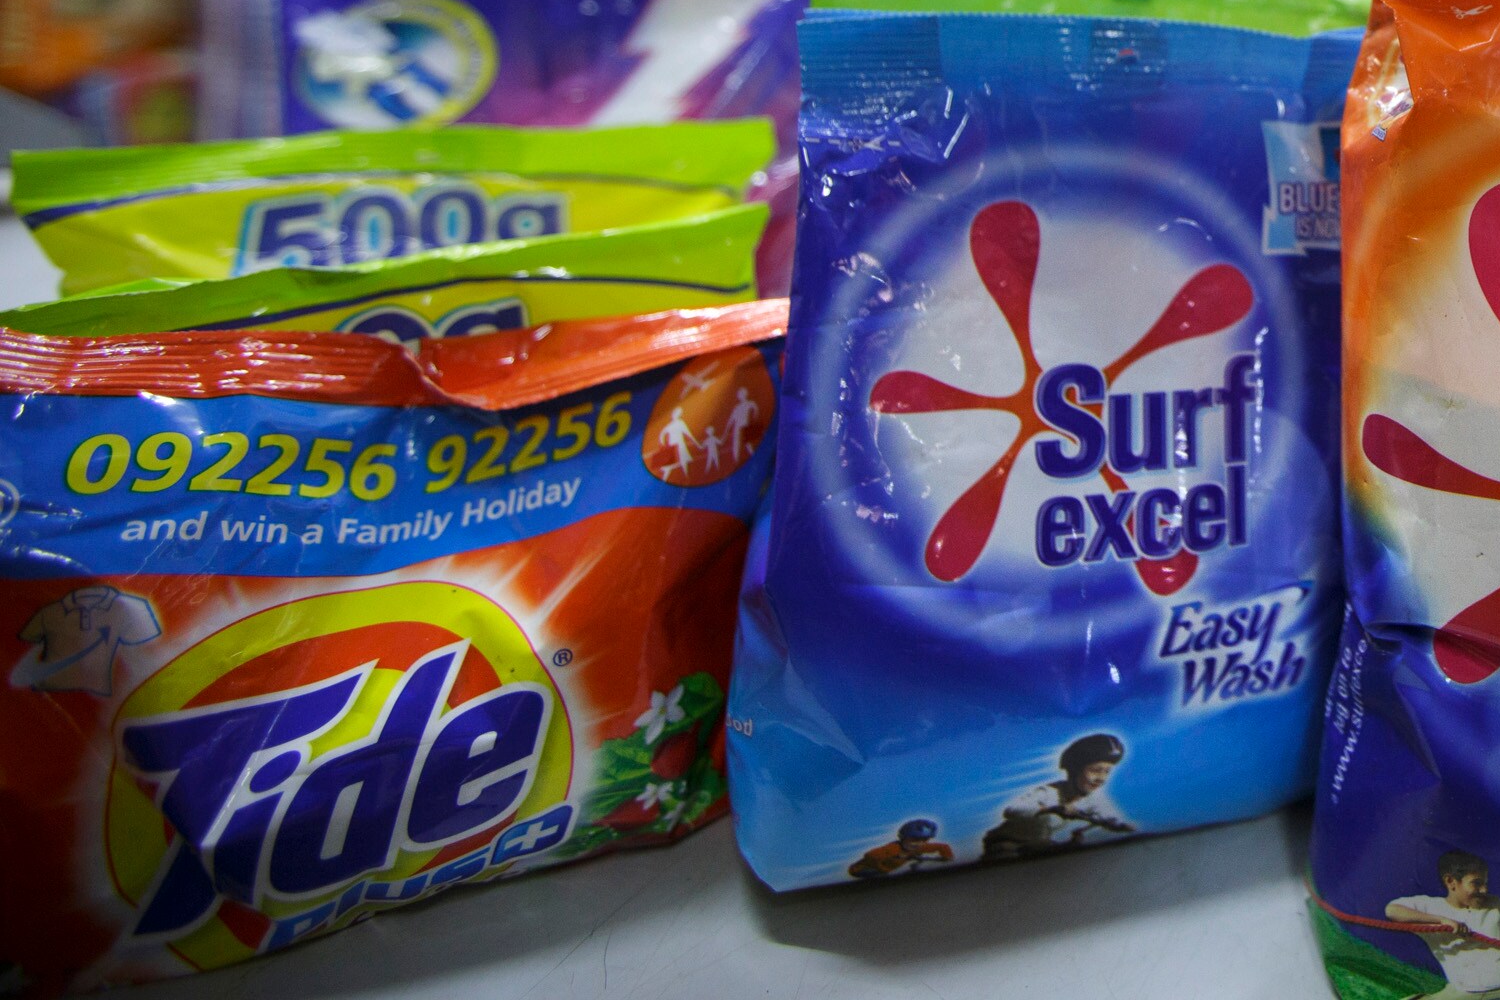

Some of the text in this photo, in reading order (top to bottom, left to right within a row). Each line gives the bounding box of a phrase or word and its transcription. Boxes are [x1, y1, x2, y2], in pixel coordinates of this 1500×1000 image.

[66, 391, 633, 501] 092256 92256
[1035, 354, 1257, 479] Surf
[120, 477, 581, 545] and win a Family Holiday
[1035, 464, 1249, 567] excel
[1160, 601, 1283, 663] Easy
[1182, 642, 1307, 706] Wash
[118, 638, 553, 938] Tide
